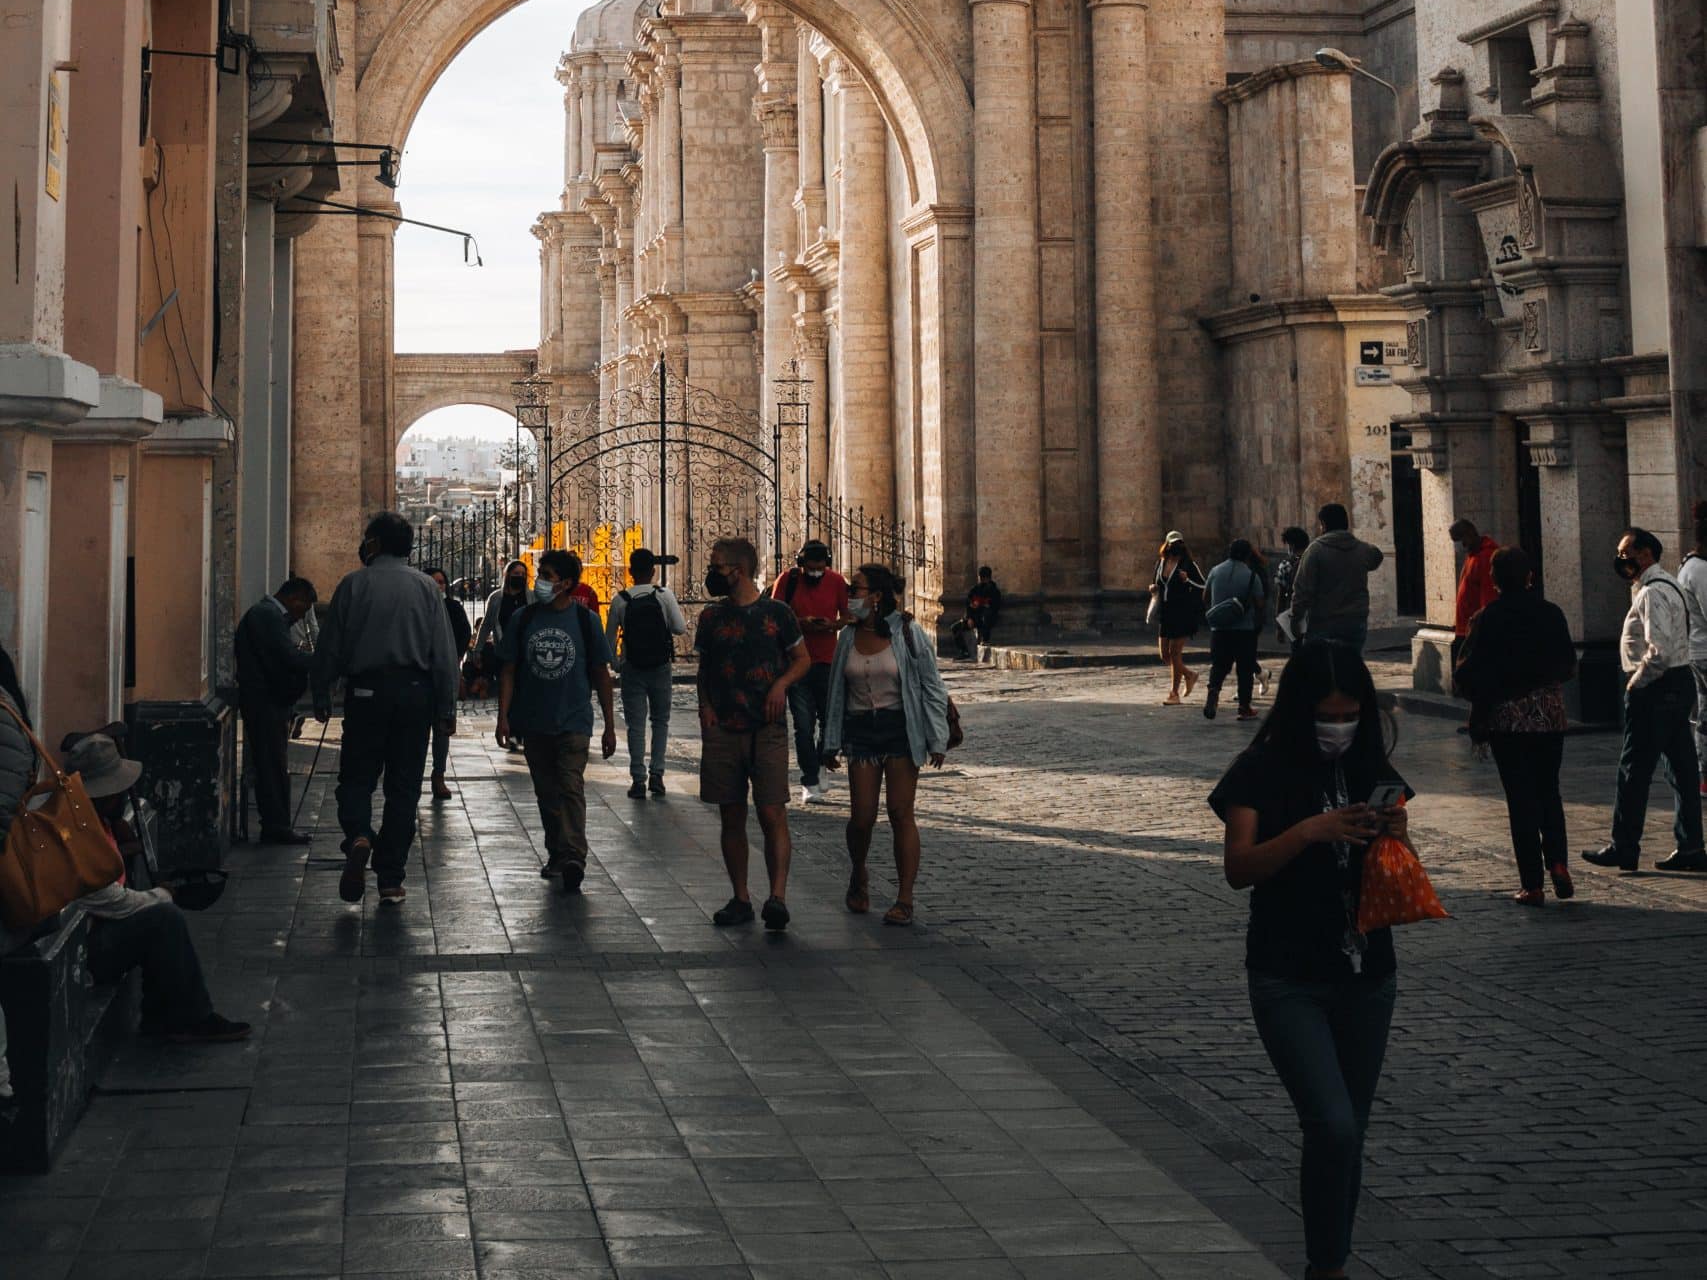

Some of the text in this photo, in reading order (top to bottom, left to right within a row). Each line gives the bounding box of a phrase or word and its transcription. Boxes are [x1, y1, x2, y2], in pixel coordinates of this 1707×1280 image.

[1386, 348, 1395, 357] SAN
[1365, 425, 1387, 436] 101
[536, 640, 565, 648] adidas
